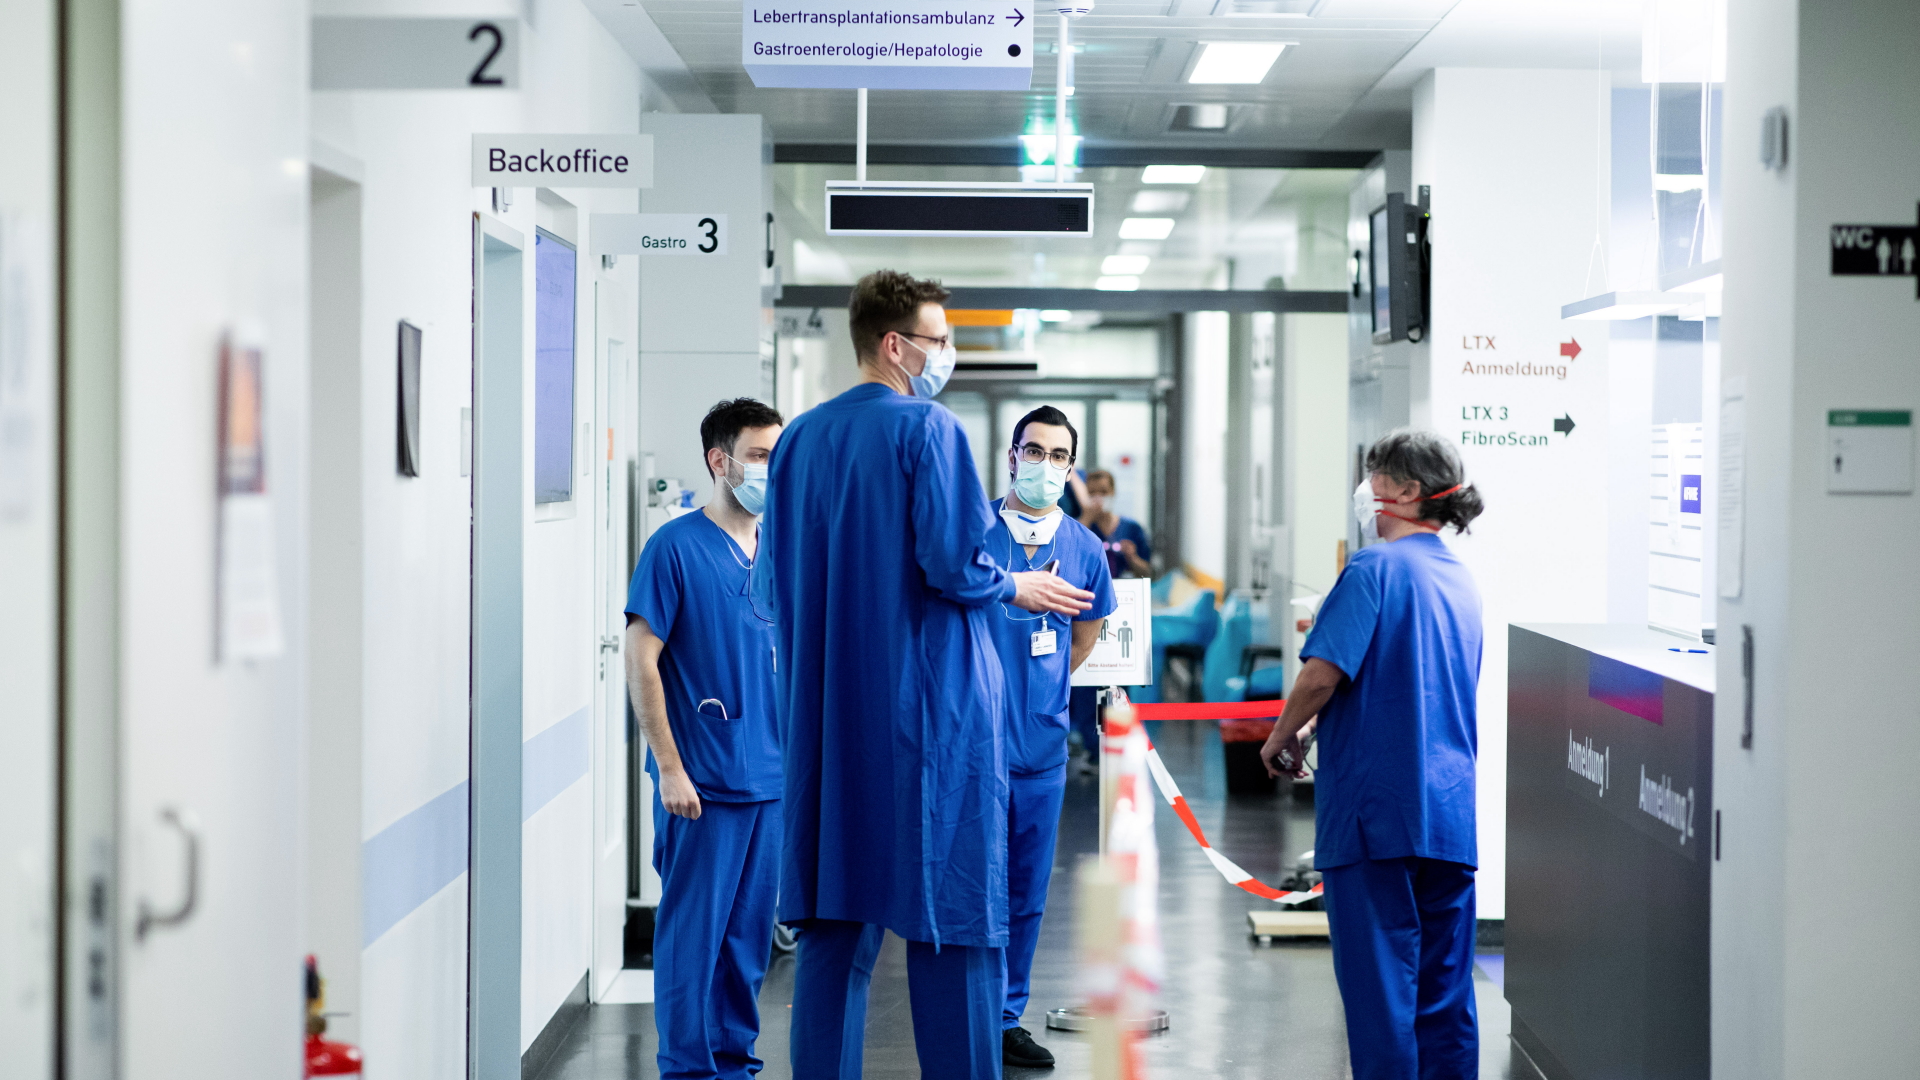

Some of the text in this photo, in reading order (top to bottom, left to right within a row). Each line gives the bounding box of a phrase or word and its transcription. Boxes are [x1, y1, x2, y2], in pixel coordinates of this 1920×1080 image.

[753, 9, 995, 27] Lebertransplantationsambulanz
[467, 22, 504, 87] 2
[753, 41, 983, 60] Gastroenterologie/Hepatologie
[488, 148, 629, 173] Backoffice
[641, 217, 719, 254] Gastro 3
[1832, 227, 1874, 249] WC
[1463, 335, 1496, 350] LTX
[1462, 361, 1567, 380] Anmeldung
[1462, 406, 1508, 421] LTX 3
[1461, 431, 1548, 446] FibroScan
[1567, 728, 1609, 798] Anmeldung 1
[1638, 763, 1695, 846] Anmeldung 2
